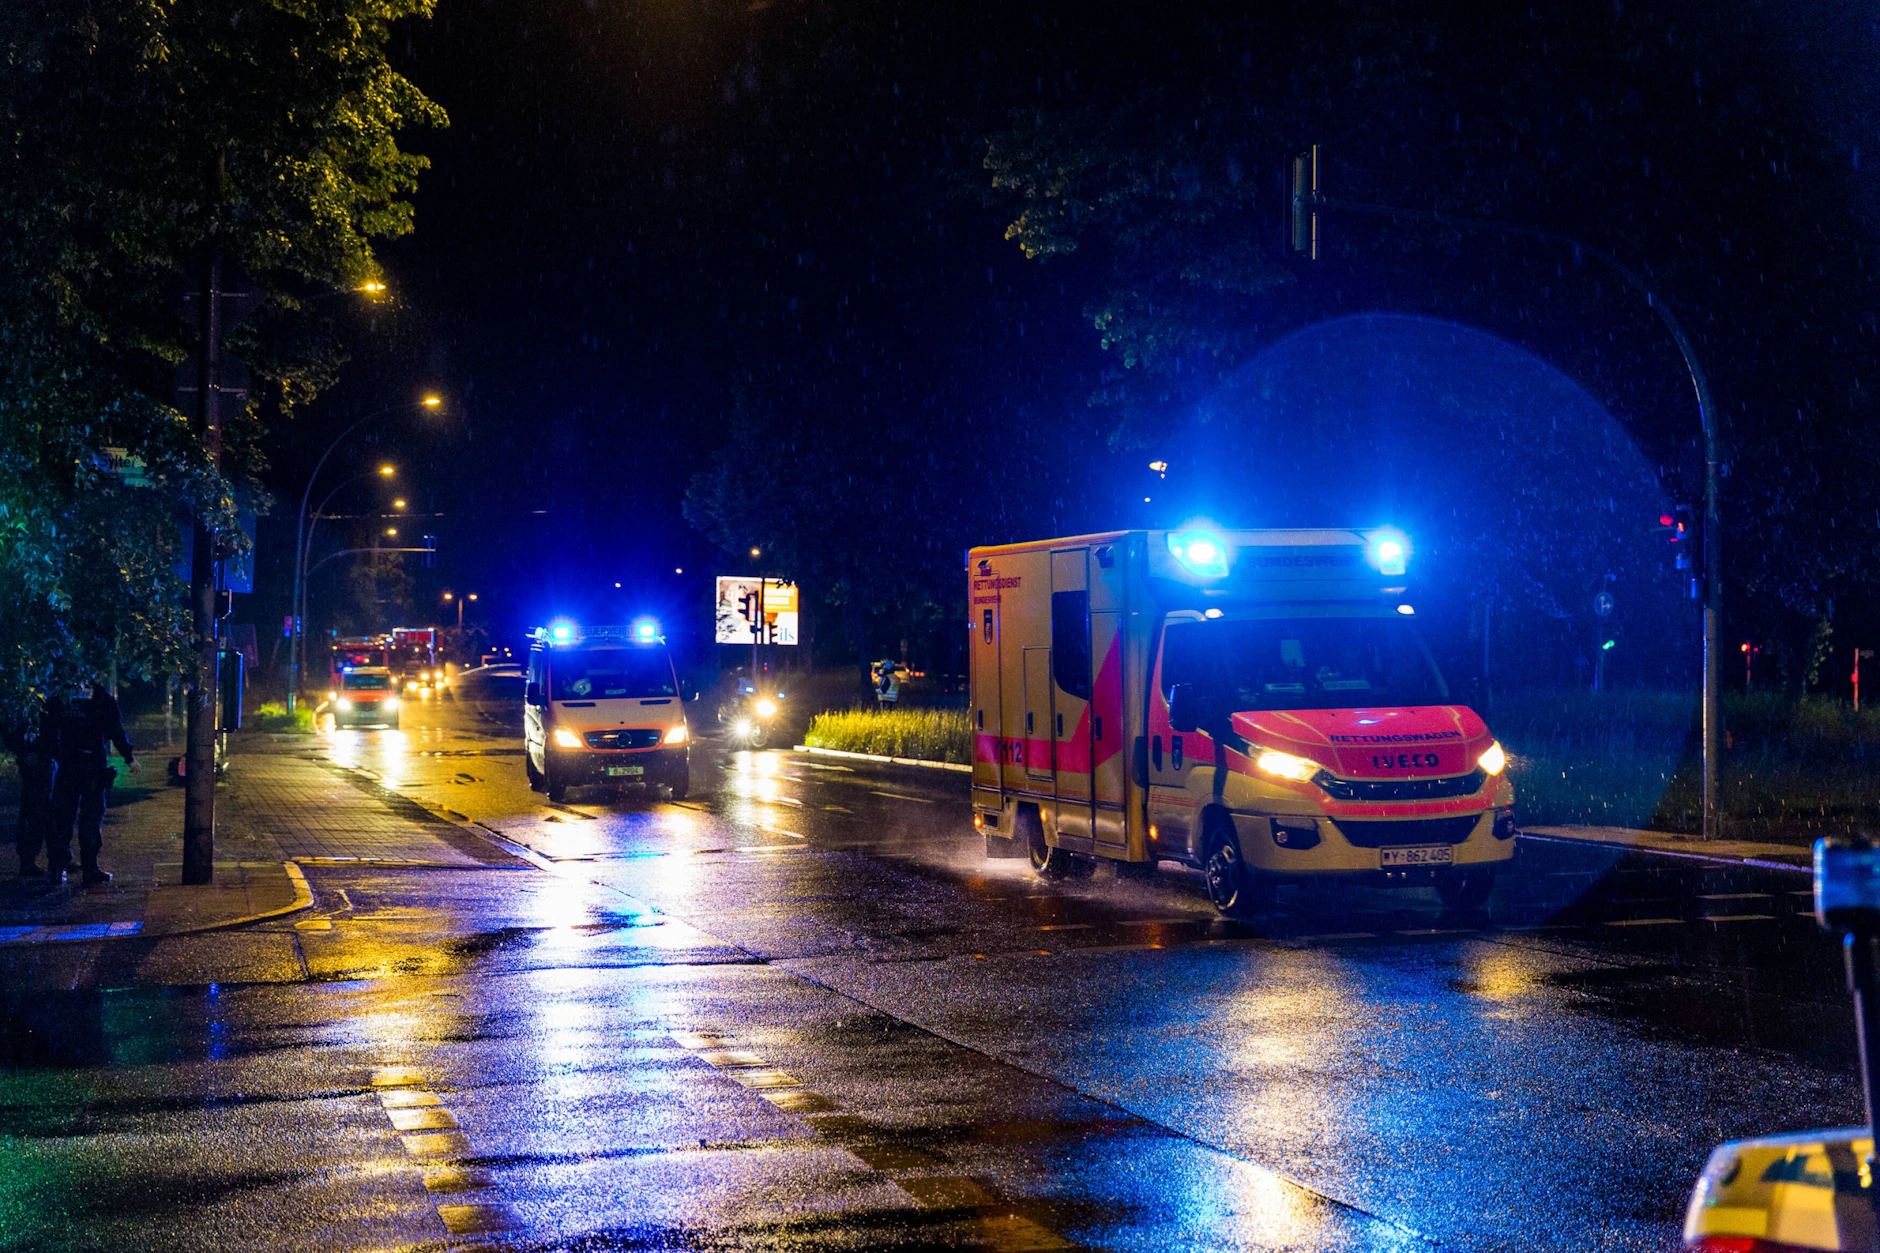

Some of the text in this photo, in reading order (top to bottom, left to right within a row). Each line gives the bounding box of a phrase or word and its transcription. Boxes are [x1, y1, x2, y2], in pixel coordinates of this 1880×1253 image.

[974, 577, 1021, 591] RETTUNGSDIENST
[1329, 730, 1462, 743] RETTUNGSWAGEN
[1003, 742, 1022, 763] 112
[1371, 753, 1440, 769] IVECO
